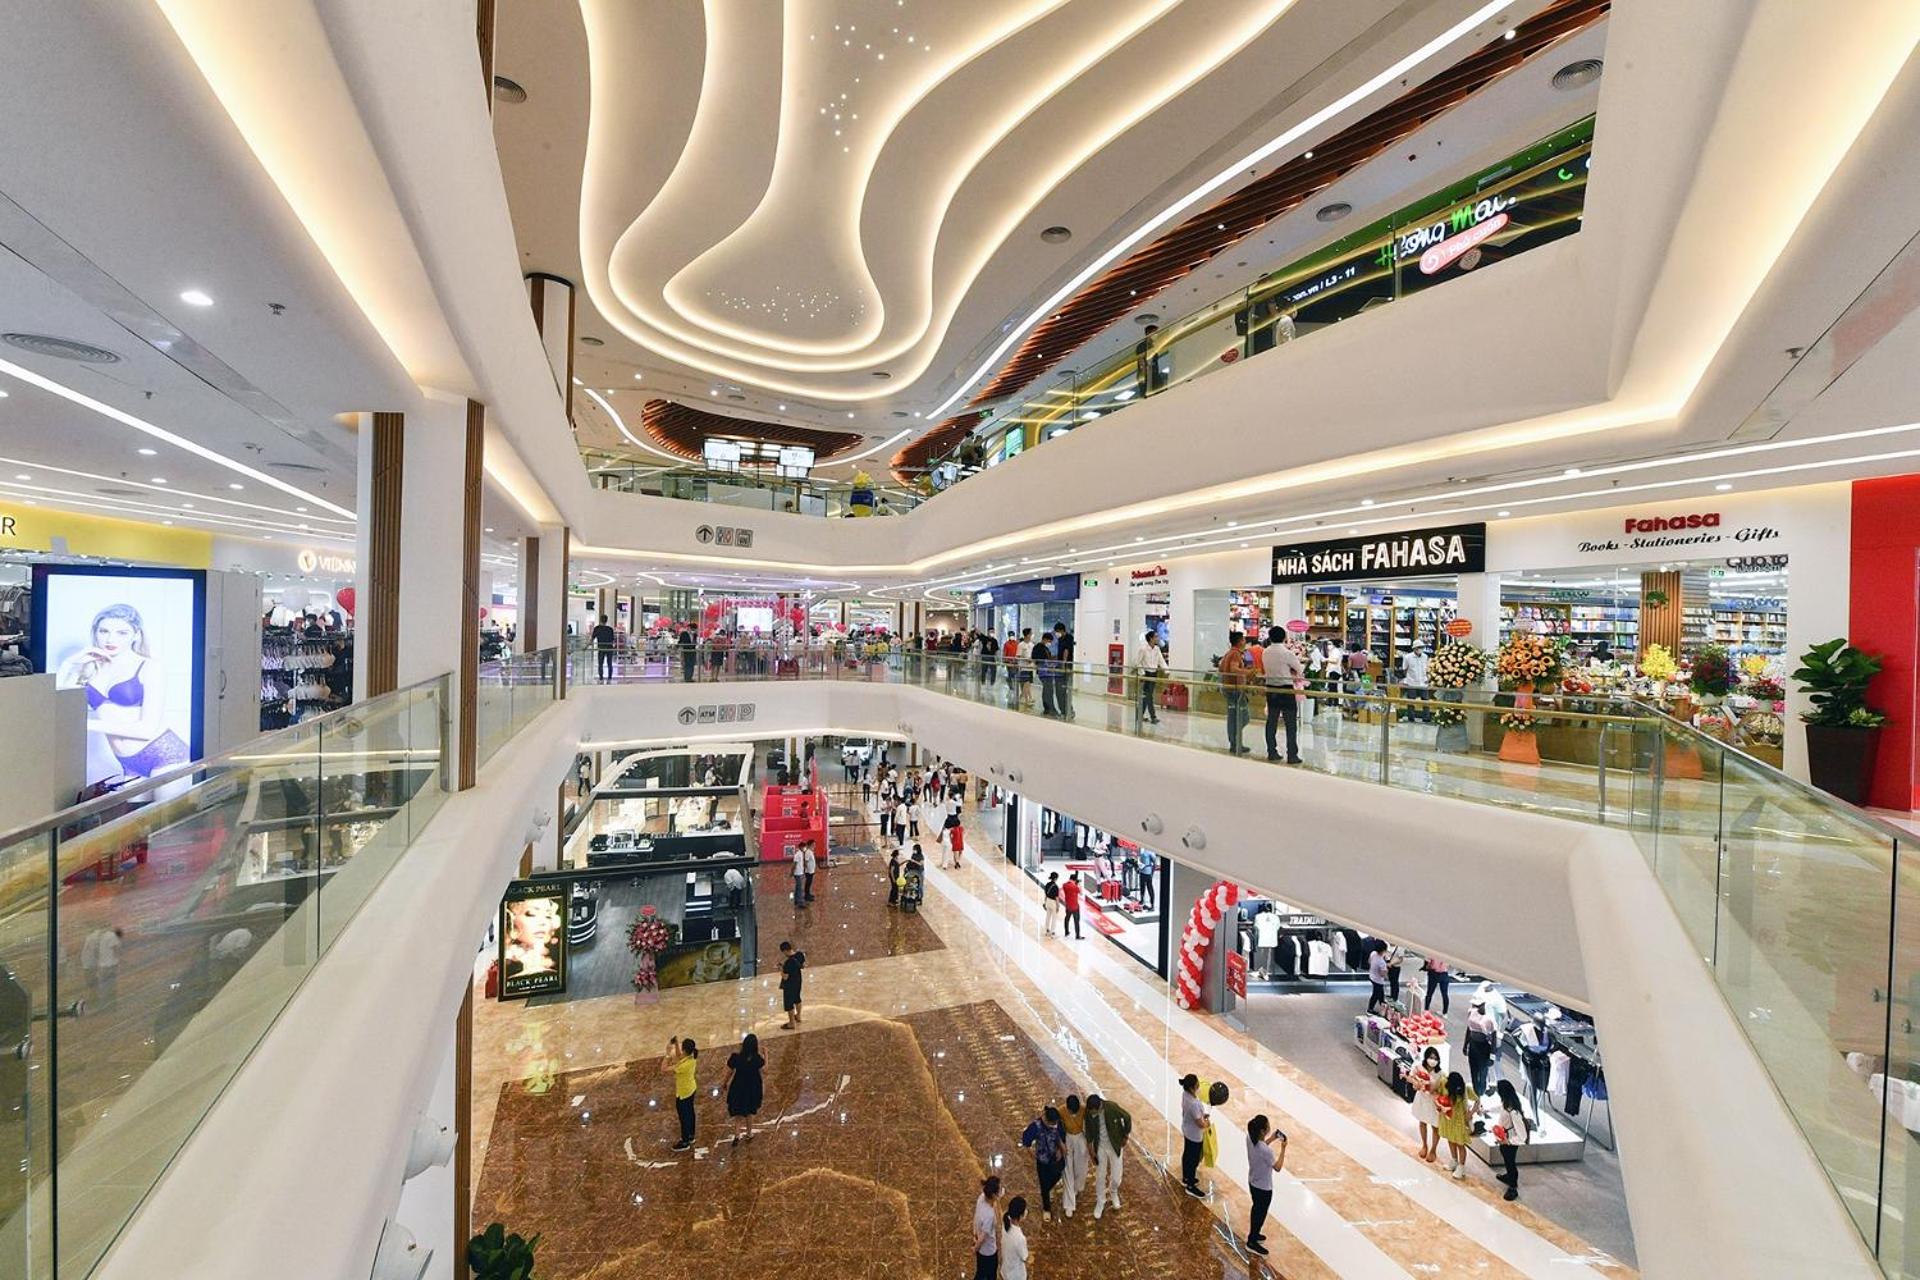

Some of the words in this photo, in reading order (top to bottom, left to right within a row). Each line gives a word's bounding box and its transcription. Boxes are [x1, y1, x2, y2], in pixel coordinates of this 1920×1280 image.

[1625, 512, 1720, 534] Fahasa
[1577, 540, 1619, 553] Books
[1630, 532, 1721, 550] Stationeries
[1735, 527, 1779, 543] Gifts
[1277, 552, 1307, 576] NHÀ
[1311, 549, 1354, 574] SÁCH
[1361, 534, 1467, 570] FAHASA
[507, 979, 531, 988] BLACK
[535, 975, 558, 984] PEARL
